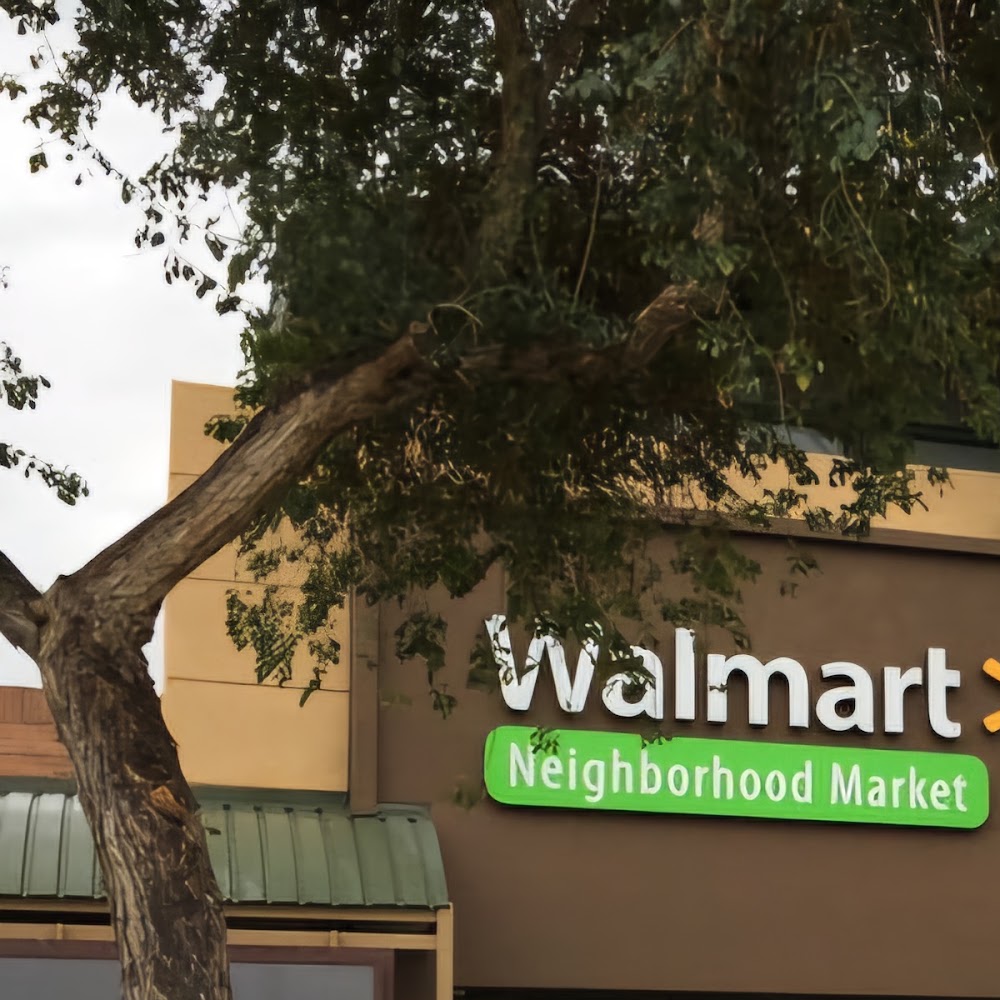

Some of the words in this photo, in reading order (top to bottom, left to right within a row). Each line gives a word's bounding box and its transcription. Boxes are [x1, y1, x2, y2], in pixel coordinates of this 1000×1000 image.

[485, 614, 961, 738] Walmart
[509, 742, 813, 804] Neighborhood
[830, 763, 968, 813] Market
